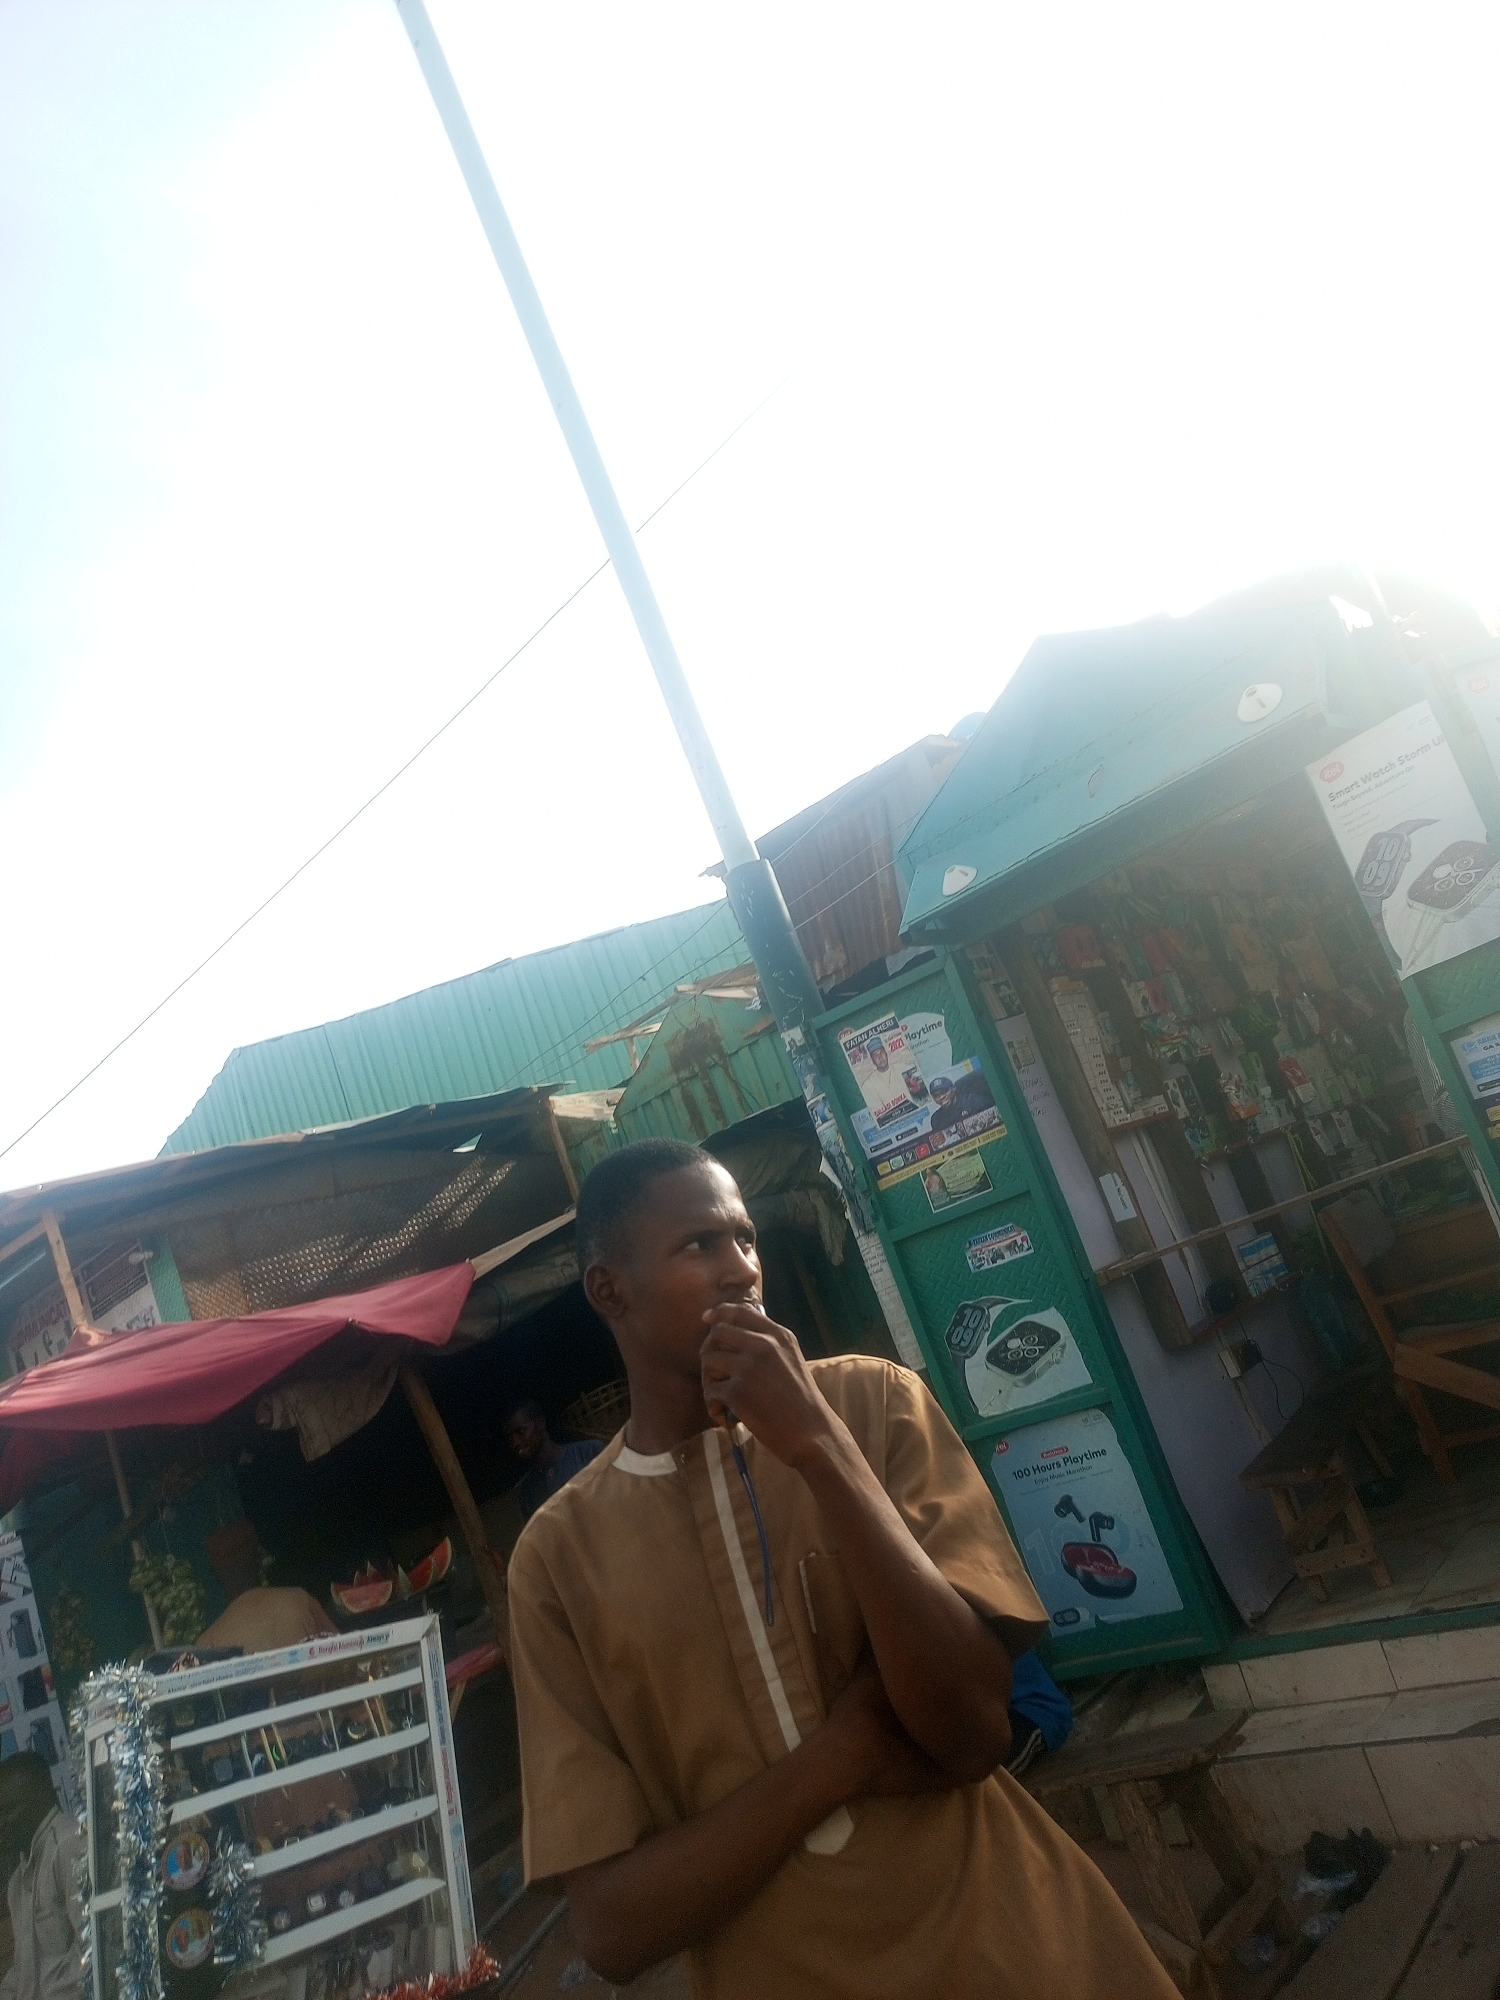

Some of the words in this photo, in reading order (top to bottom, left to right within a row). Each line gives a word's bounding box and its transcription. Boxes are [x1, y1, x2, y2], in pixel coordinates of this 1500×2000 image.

[1328, 780, 1360, 802] Smart
[1360, 761, 1396, 785] Watch
[1397, 743, 1431, 766] Storm
[1012, 1468, 1031, 1481] 100
[1031, 1460, 1062, 1475] Hours
[1062, 1448, 1107, 1467] Playtime
